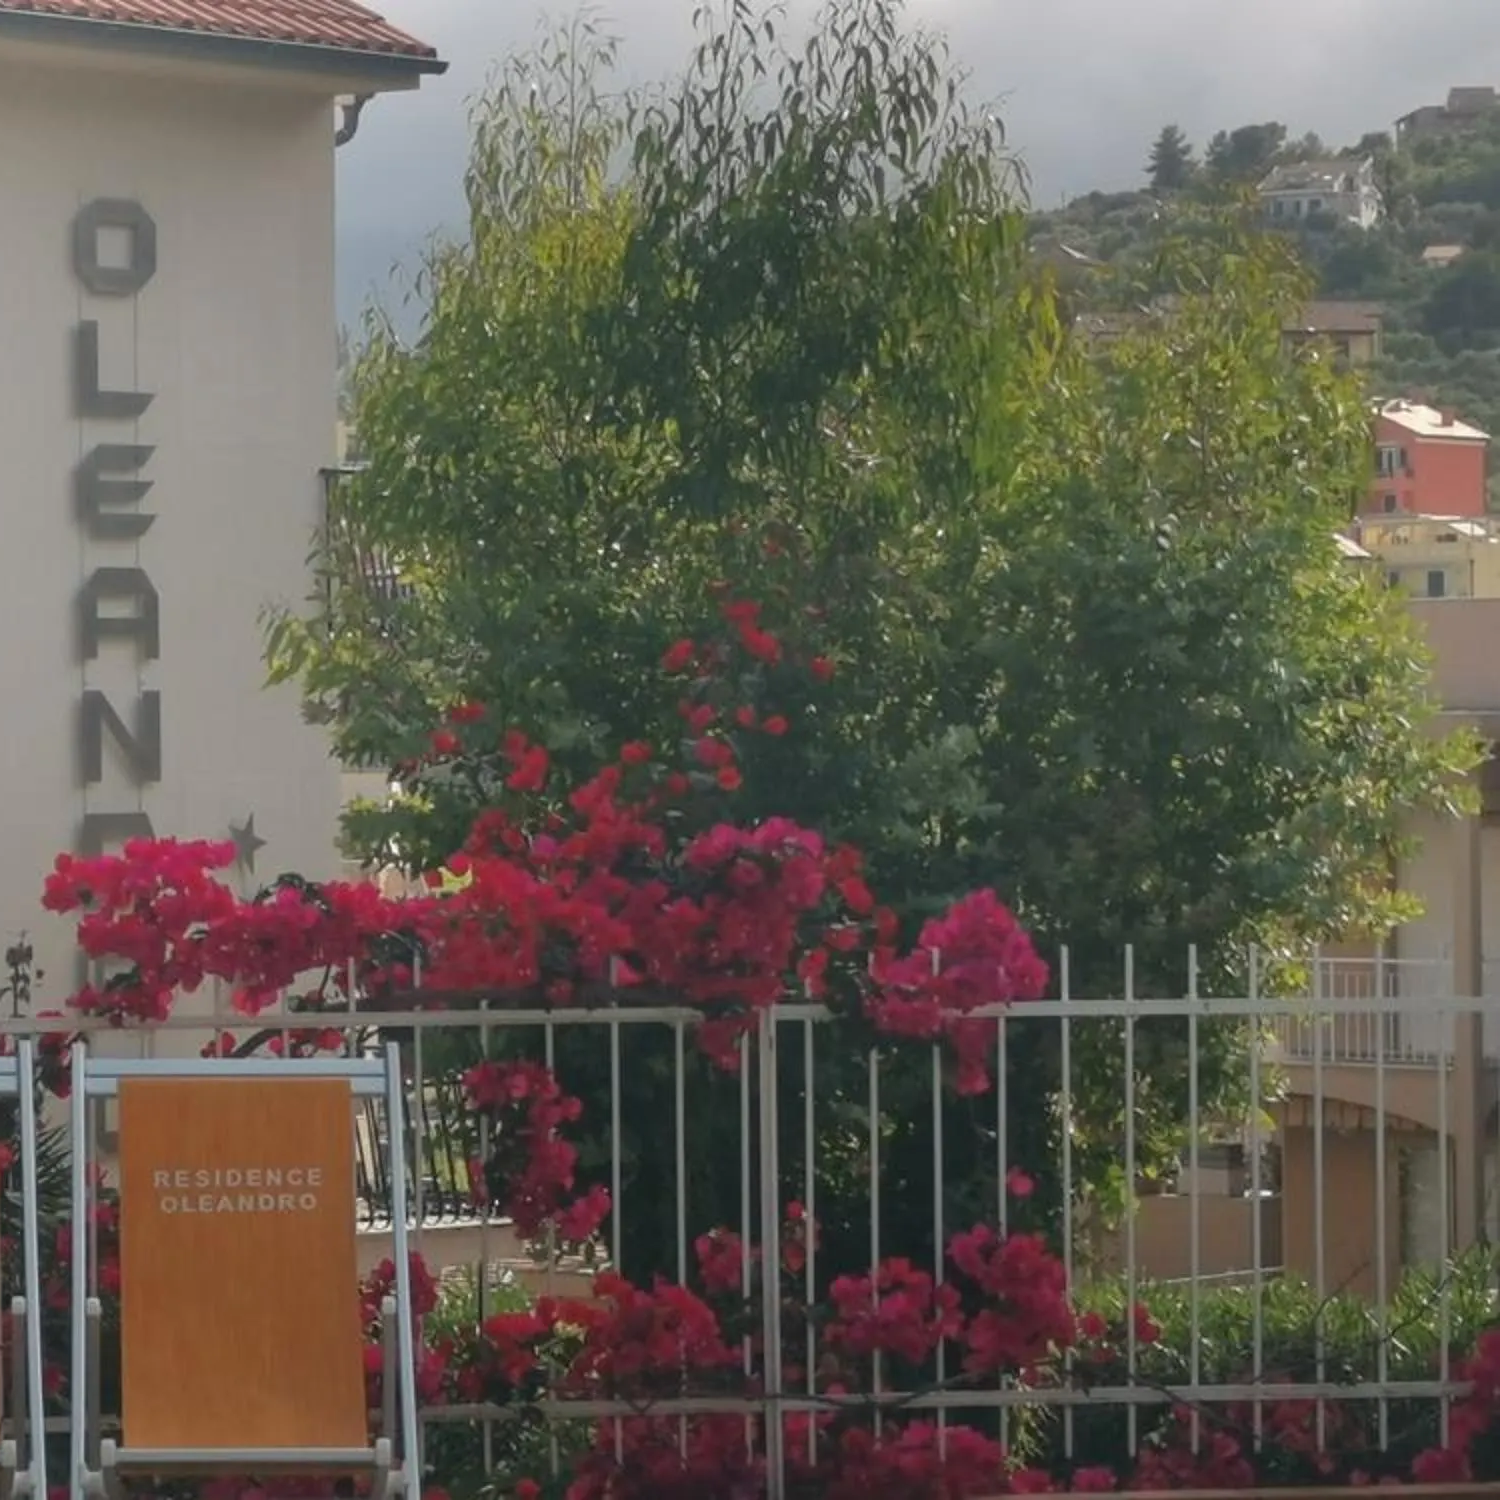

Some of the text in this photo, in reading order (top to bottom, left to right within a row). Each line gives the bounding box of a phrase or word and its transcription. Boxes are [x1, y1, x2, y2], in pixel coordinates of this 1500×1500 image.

[71, 195, 161, 1154] OLEAN
[153, 1167, 322, 1188] RESIDENCE
[160, 1193, 317, 1213] OLEANDRO
